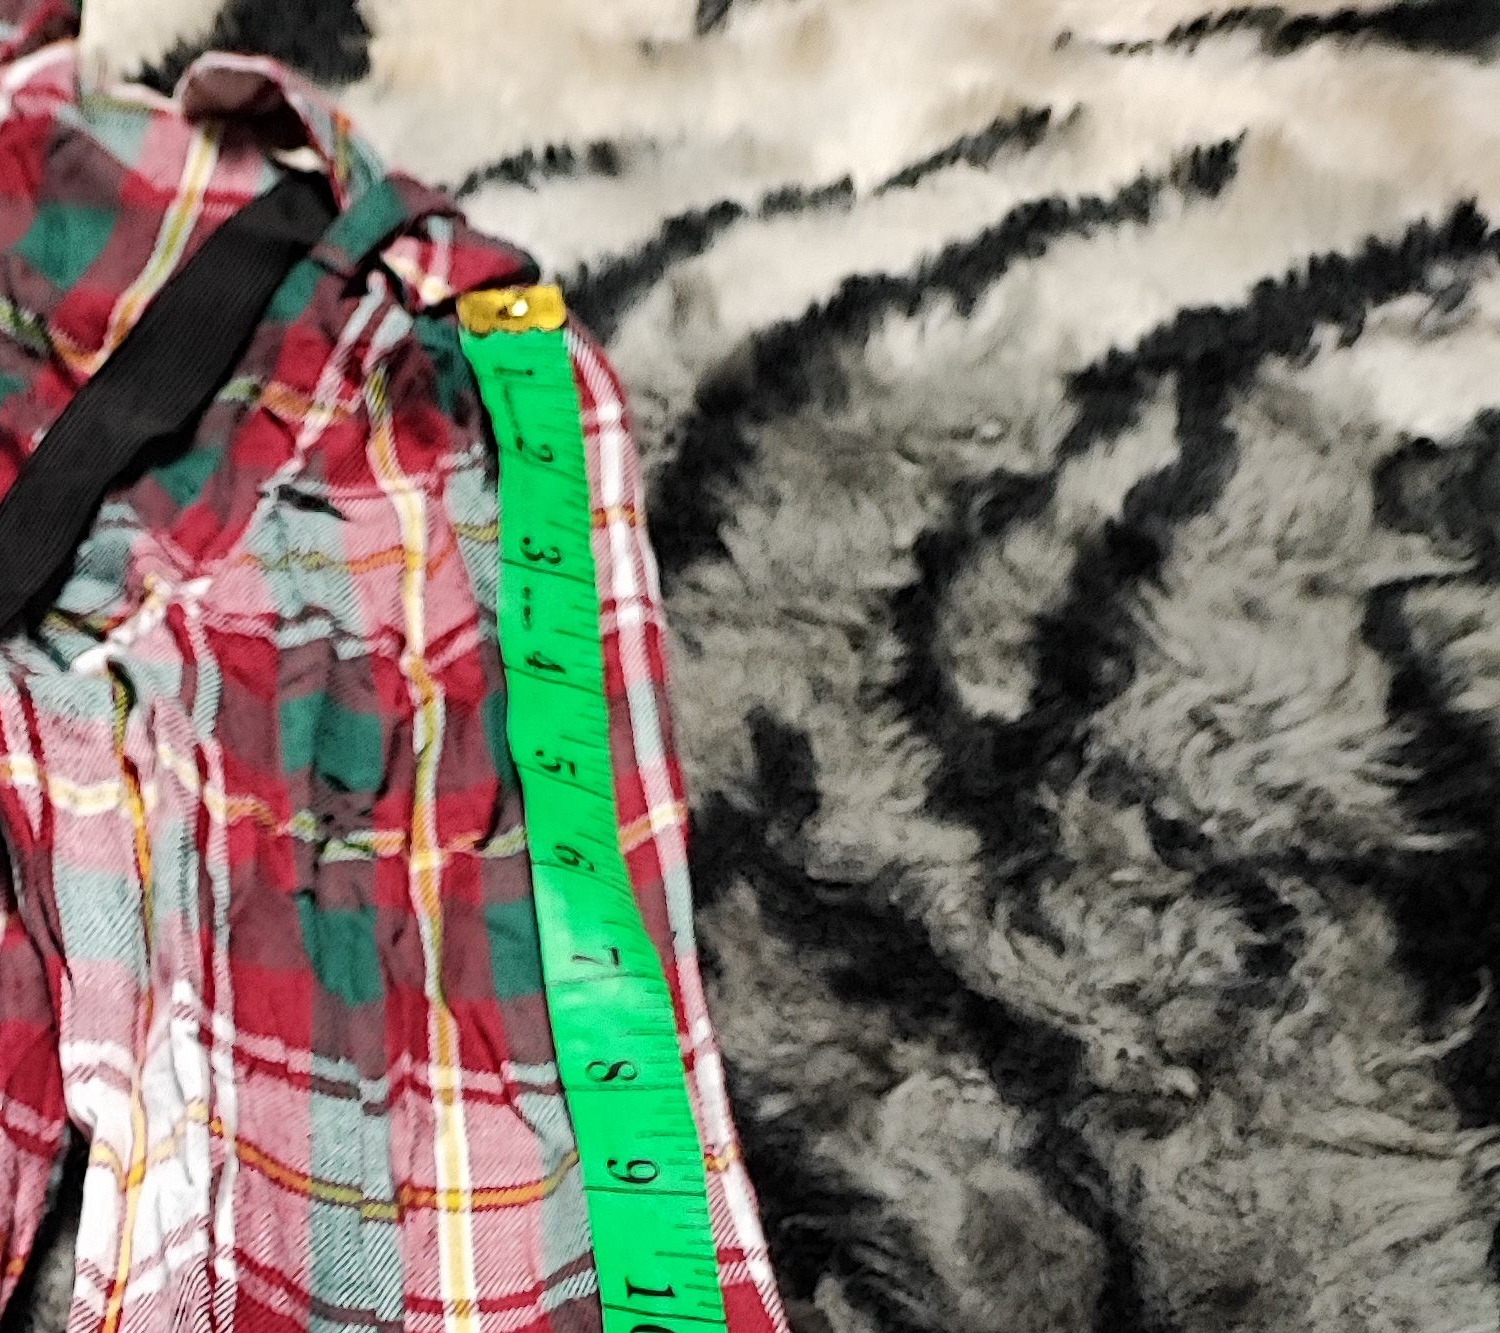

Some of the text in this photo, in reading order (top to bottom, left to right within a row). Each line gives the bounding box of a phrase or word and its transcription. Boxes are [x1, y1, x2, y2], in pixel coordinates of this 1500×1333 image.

[520, 537, 561, 565] 3
[535, 749, 577, 777] 5
[554, 843, 595, 872] 6
[572, 947, 620, 967] 7
[585, 1060, 638, 1083] 8
[606, 1158, 660, 1184] 9
